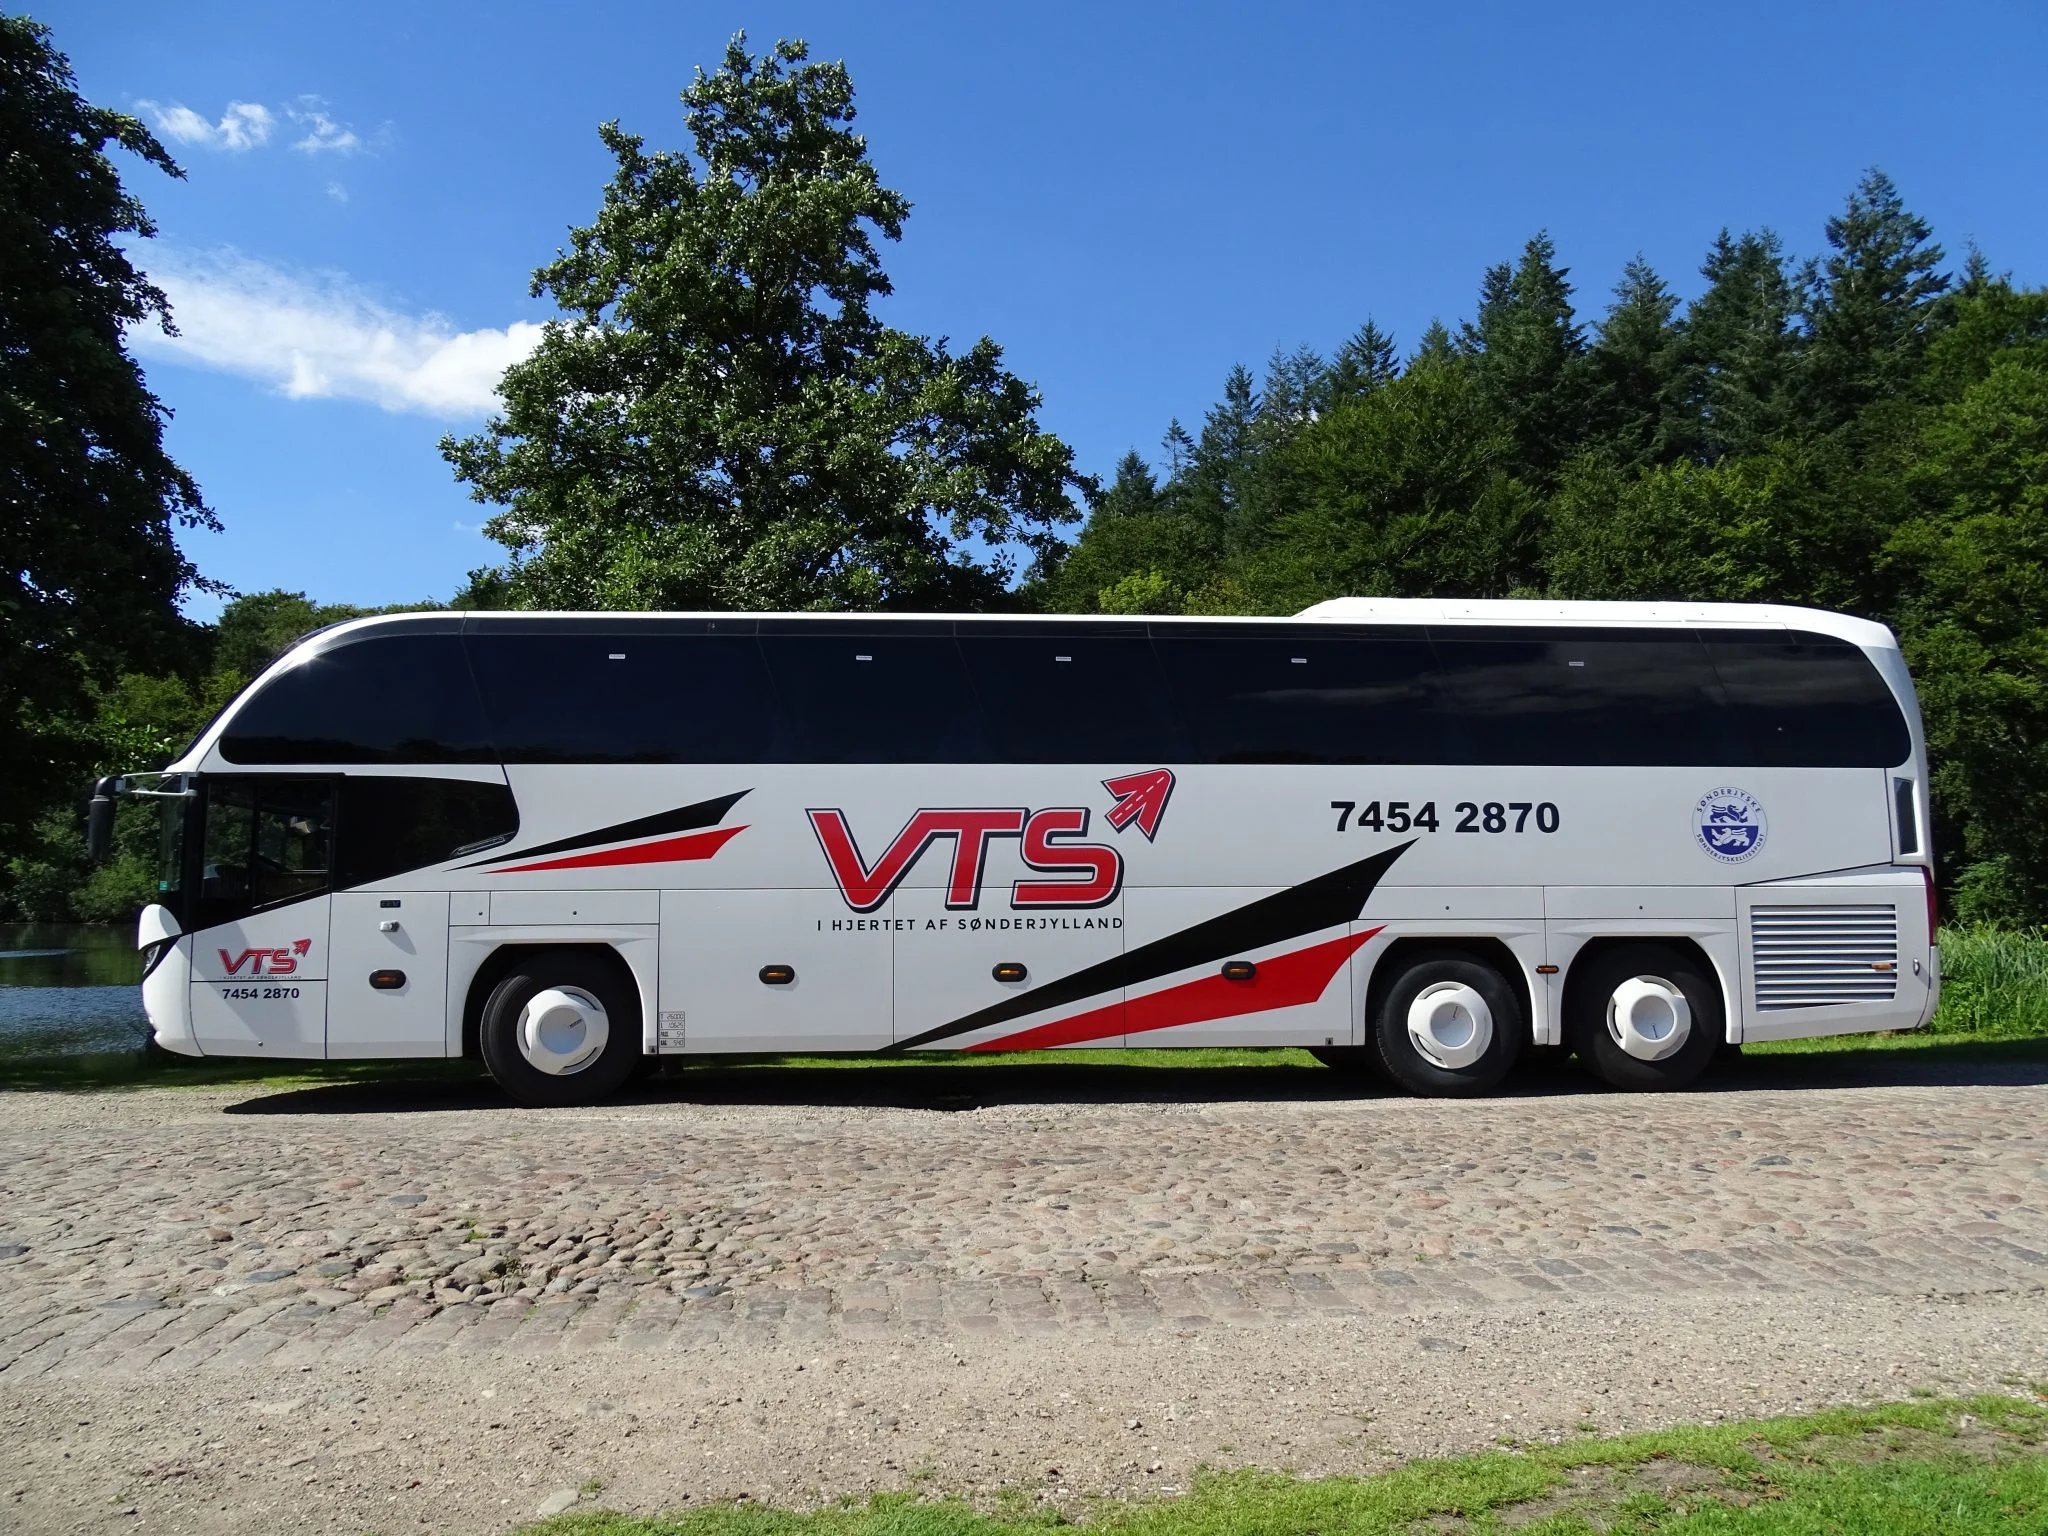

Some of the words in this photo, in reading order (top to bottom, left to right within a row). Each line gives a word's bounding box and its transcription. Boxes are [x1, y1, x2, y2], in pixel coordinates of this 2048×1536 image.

[1697, 788, 1761, 813] SØNDERJYSKE
[1330, 800, 1440, 833] 7454
[1454, 801, 1560, 834] 2870
[804, 806, 1125, 914] VTS
[817, 919, 821, 931] I
[832, 919, 916, 931] HJERTET
[925, 918, 948, 931] AF
[957, 917, 1123, 932] SØNDERJYLLAND
[217, 948, 298, 975] VTS
[222, 988, 259, 1000] 7454
[263, 988, 300, 999] 2870
